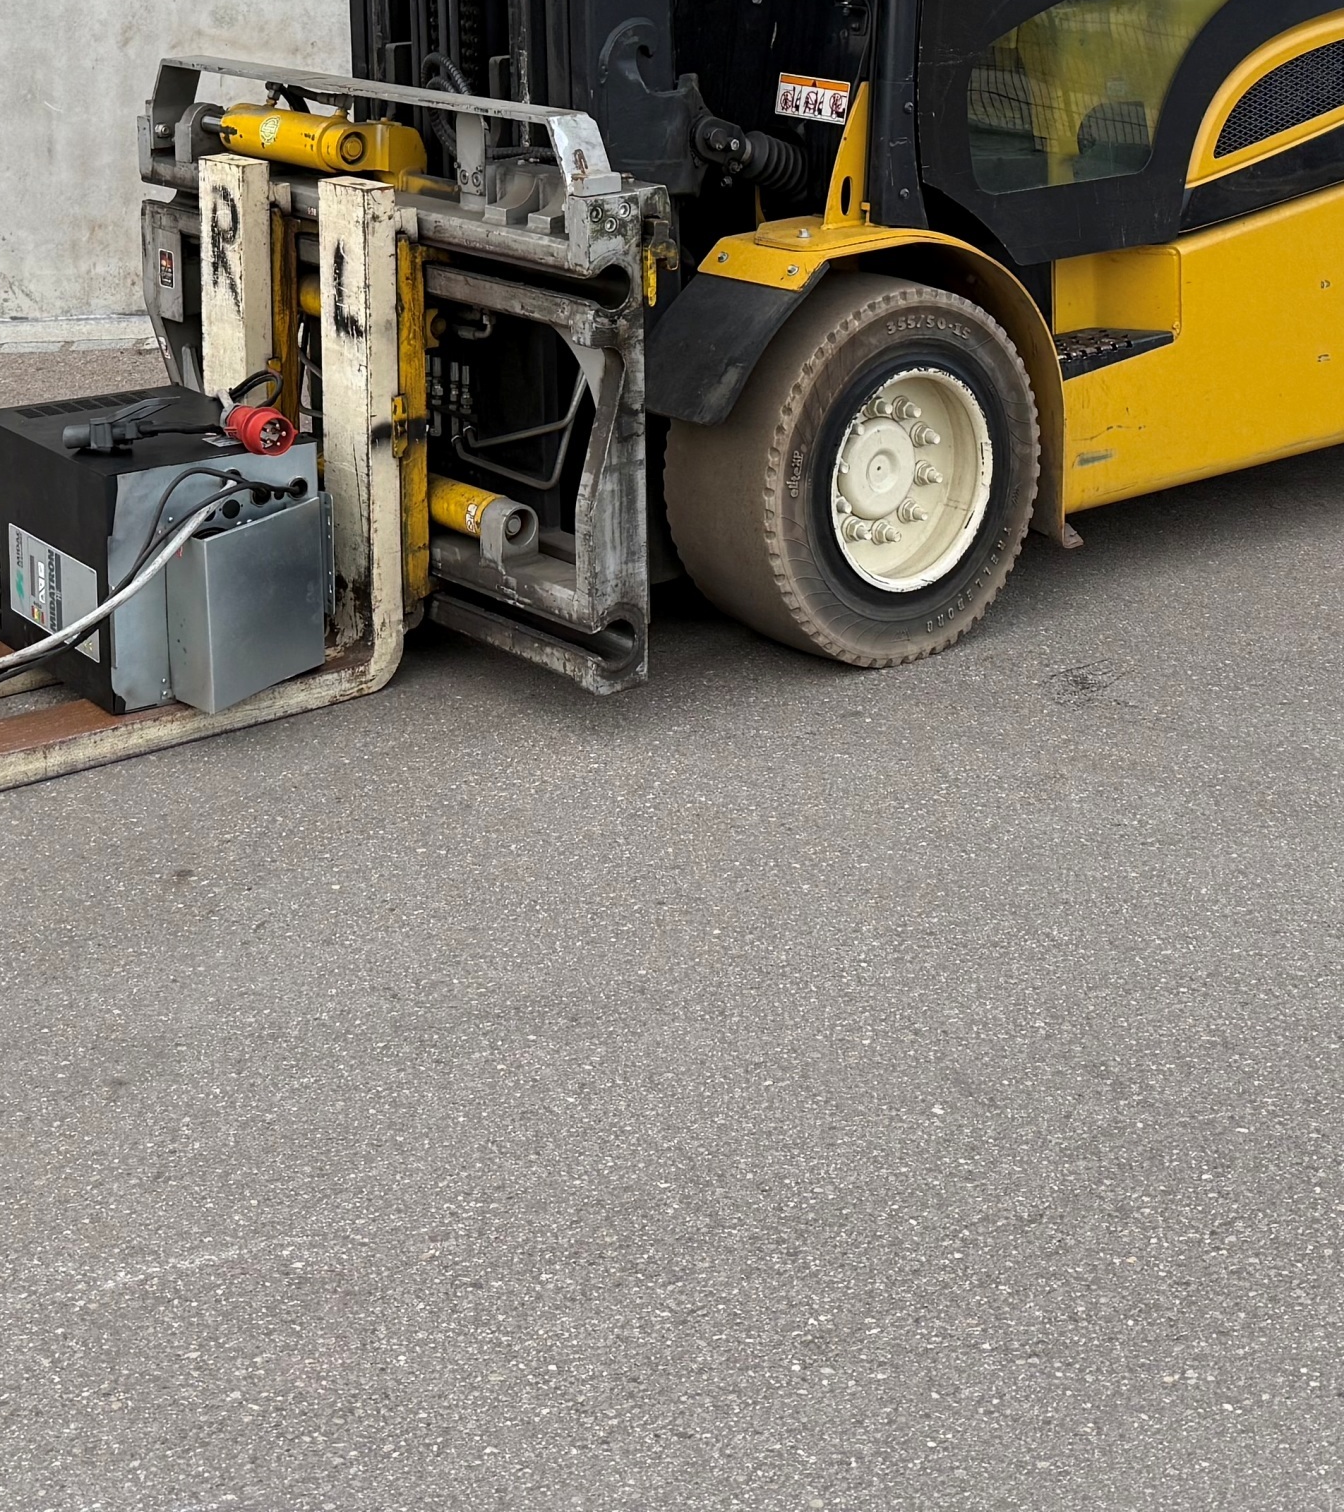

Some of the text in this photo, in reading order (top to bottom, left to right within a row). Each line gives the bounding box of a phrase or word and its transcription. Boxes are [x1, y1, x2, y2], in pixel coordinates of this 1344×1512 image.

[211, 184, 243, 317] R
[333, 240, 365, 338] L
[48, 548, 57, 634] MIDATRON
